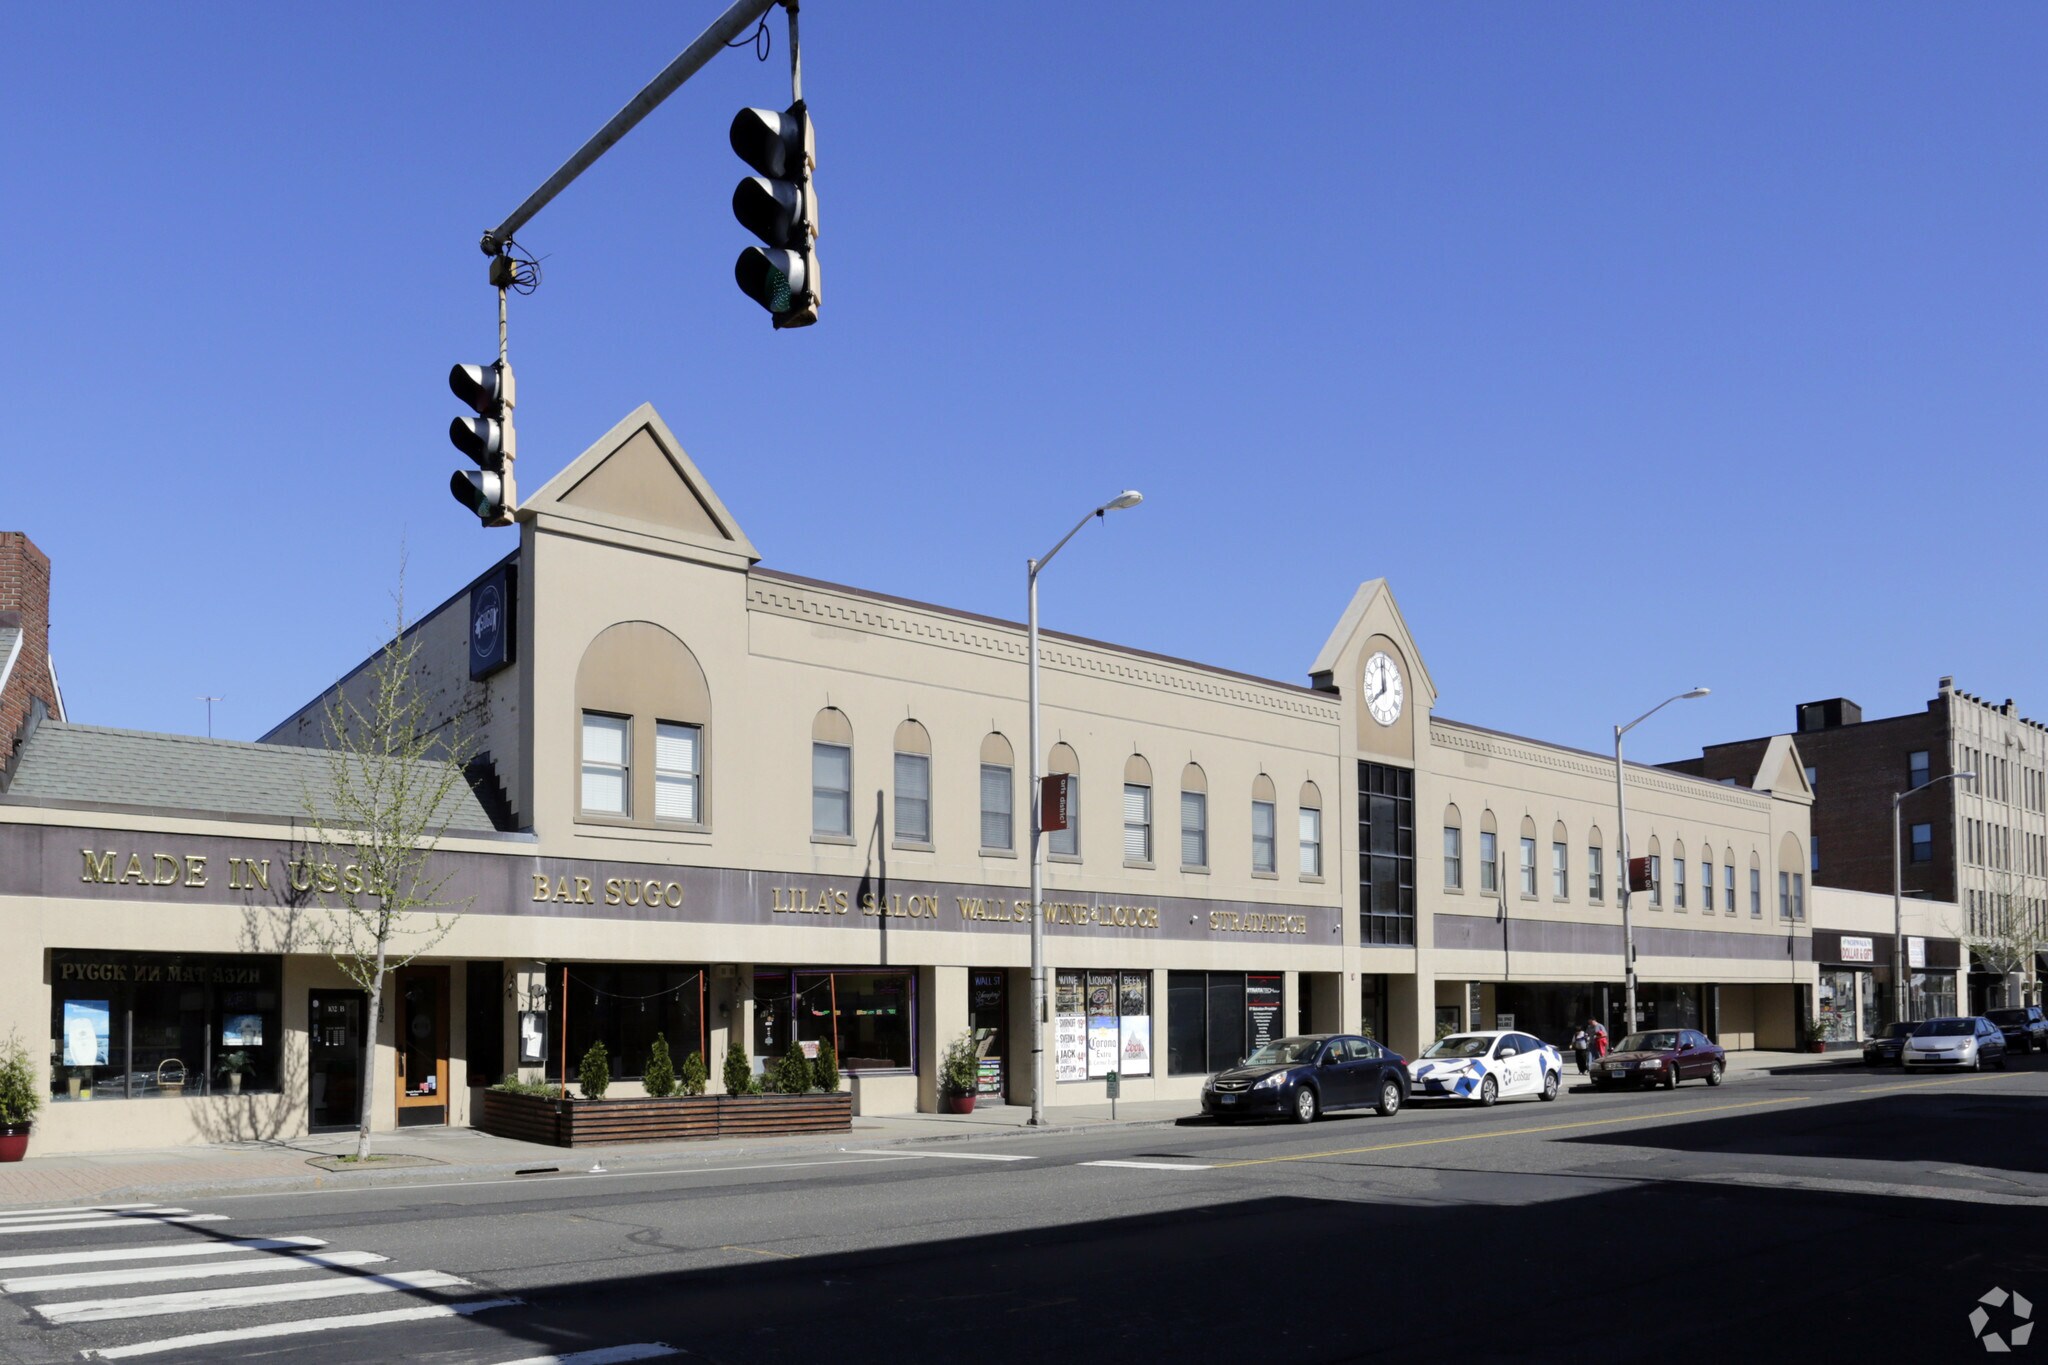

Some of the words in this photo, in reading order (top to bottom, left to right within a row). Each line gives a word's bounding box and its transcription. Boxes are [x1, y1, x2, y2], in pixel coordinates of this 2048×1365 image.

[81, 849, 208, 887] MADE
[229, 857, 270, 890] IN
[532, 873, 594, 904] BAR
[605, 878, 684, 909] SUGO
[772, 887, 849, 916] LILA'S
[862, 892, 939, 919] SALON
[956, 896, 1011, 921] WALL
[1042, 902, 1090, 926] WINE
[1090, 907, 1098, 921] &
[1098, 904, 1160, 929] LIQUOR
[1209, 910, 1307, 935] STRATATECH
[1841, 947, 1859, 959] DOLLAR
[975, 976, 992, 986] WALL
[1058, 975, 1079, 985] WINE
[1088, 975, 1113, 986] LIQUOR
[1123, 976, 1141, 985] BEER
[1088, 1037, 1117, 1051] Corona
[1060, 1049, 1076, 1059] JACK
[1096, 1050, 1111, 1058] Extra
[1513, 1070, 1533, 1082] CoStar
